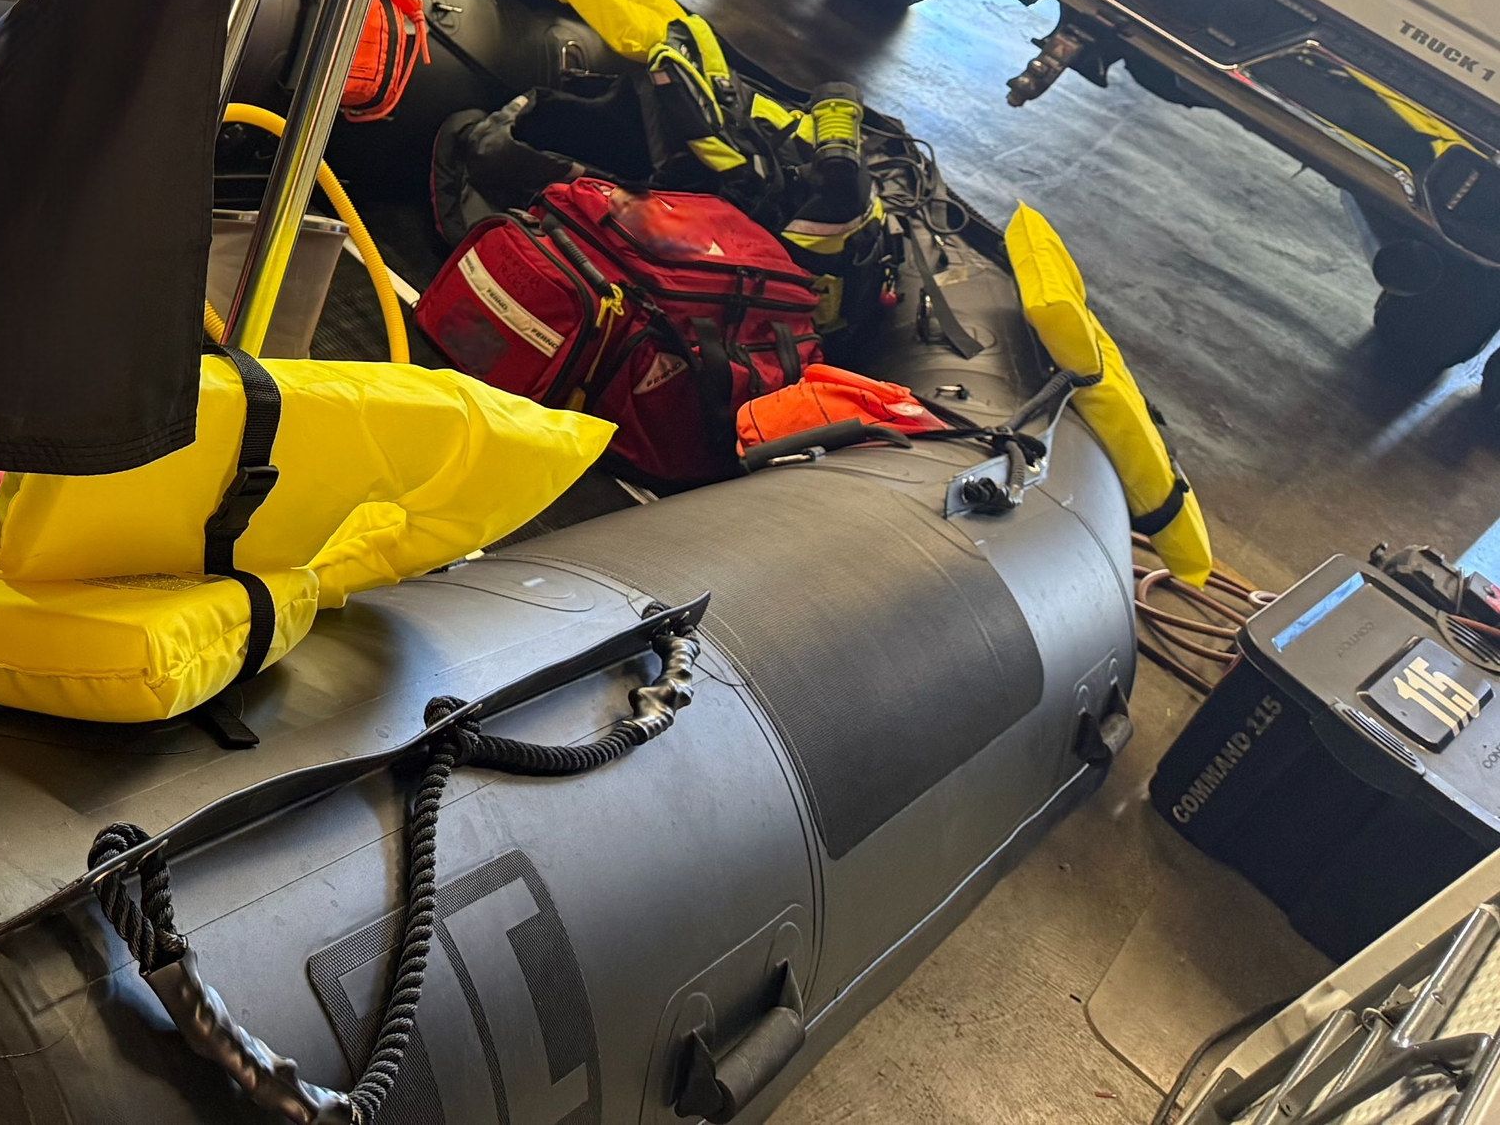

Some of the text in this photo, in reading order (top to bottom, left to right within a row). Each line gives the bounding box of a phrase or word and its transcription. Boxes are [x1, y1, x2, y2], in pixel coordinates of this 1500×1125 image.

[1399, 19, 1496, 82] TRUCK 1
[486, 288, 509, 311] FERNO
[530, 328, 559, 350] FERNO
[1393, 657, 1480, 736] 115
[1172, 695, 1283, 824] COMMAND 115
